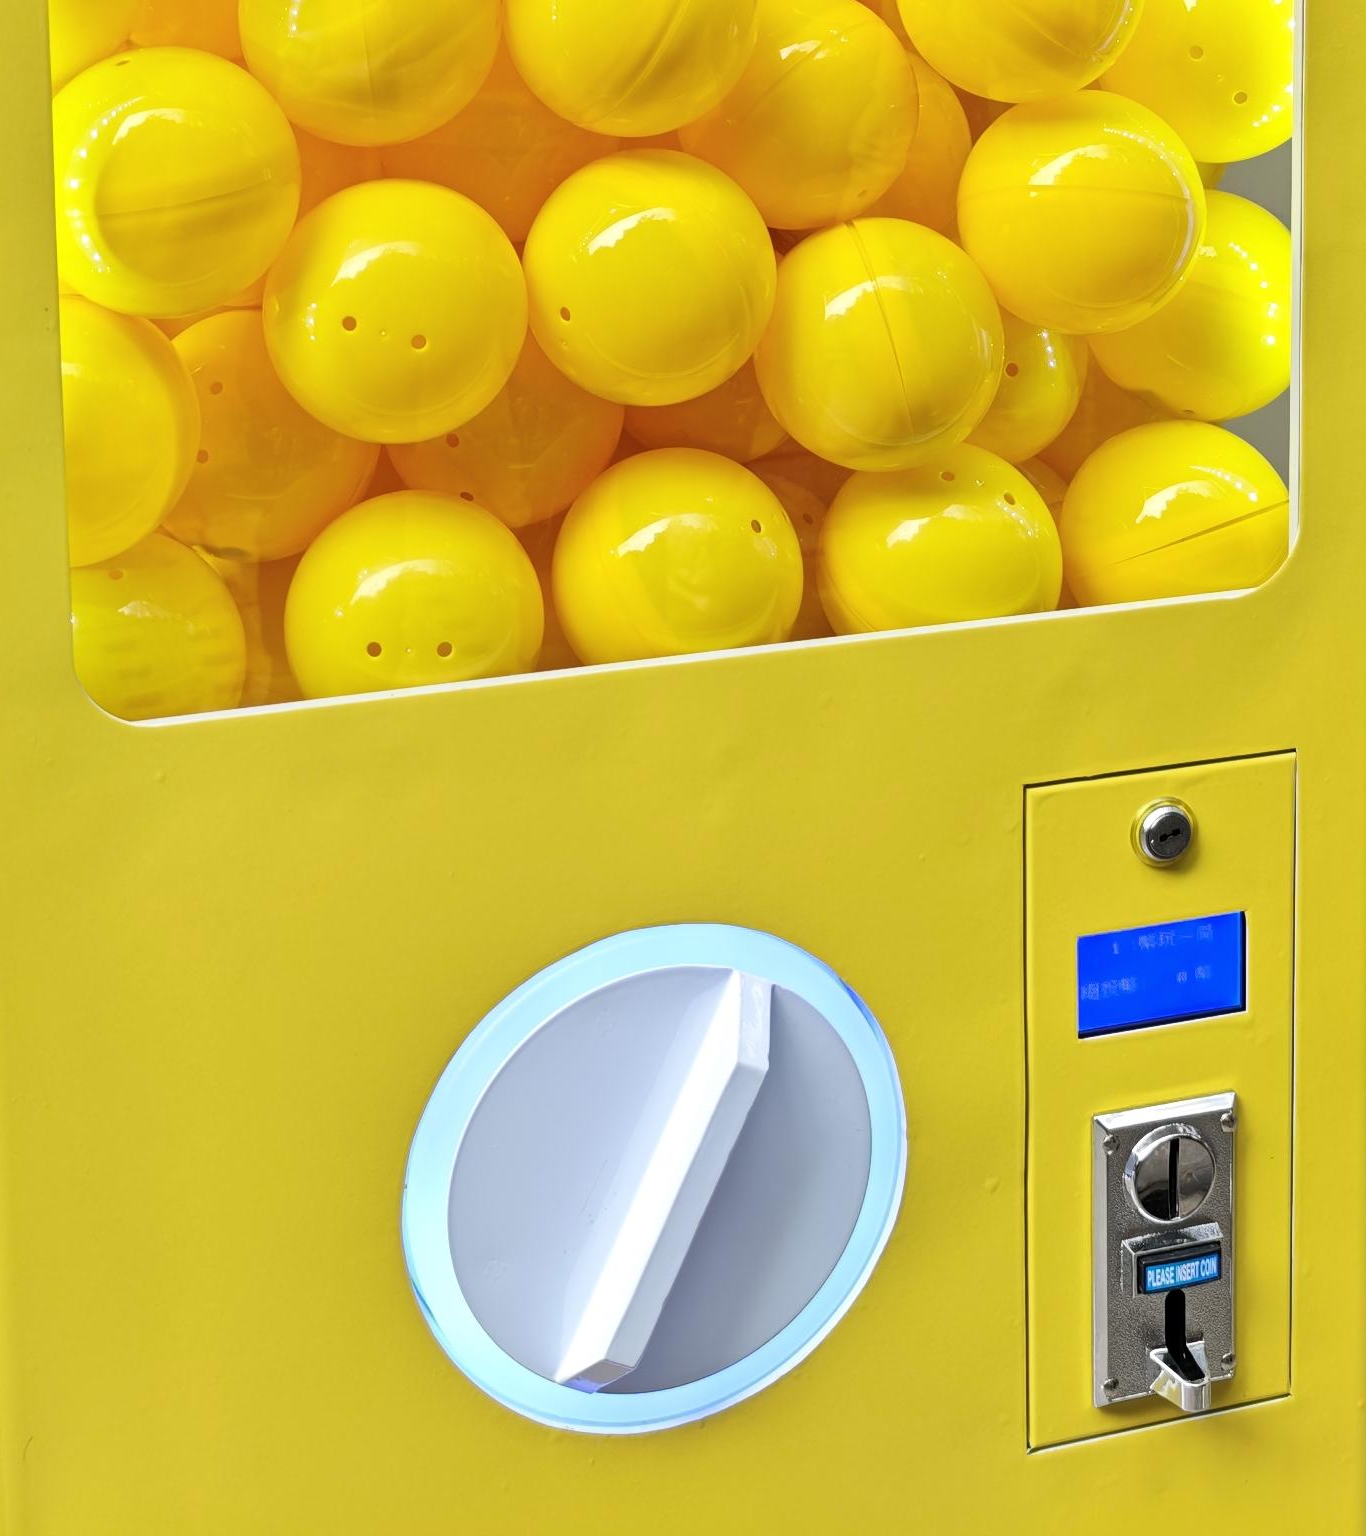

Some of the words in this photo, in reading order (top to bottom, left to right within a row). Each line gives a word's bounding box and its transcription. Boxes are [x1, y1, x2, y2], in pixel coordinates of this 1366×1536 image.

[1147, 1266, 1175, 1288] PLEASE
[1175, 1261, 1200, 1282] INSERT
[1200, 1255, 1218, 1277] COIN
